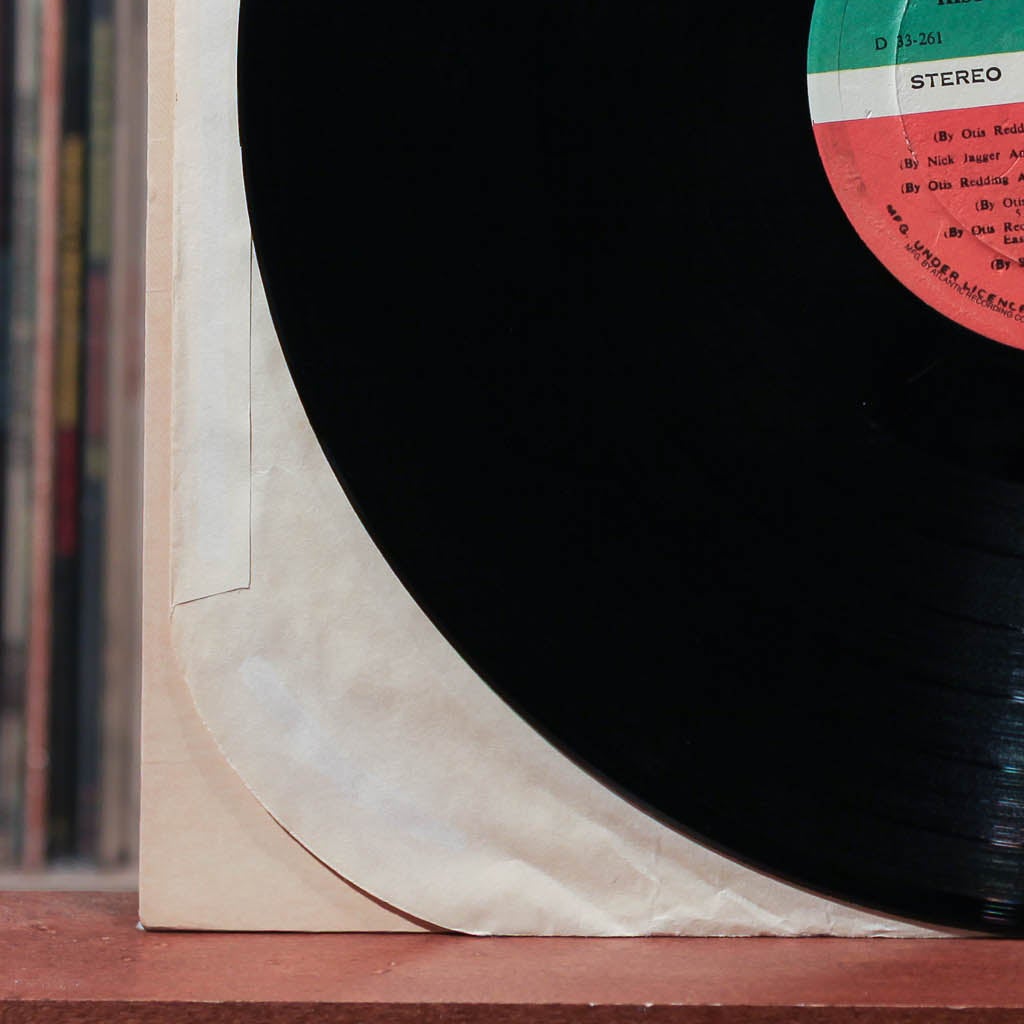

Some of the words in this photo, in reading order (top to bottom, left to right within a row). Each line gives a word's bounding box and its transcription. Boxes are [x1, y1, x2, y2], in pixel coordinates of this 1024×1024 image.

[875, 37, 888, 50] D
[911, 67, 1002, 89] STEREO
[933, 131, 953, 143] (By
[961, 128, 986, 140] Otis
[900, 158, 919, 170] (By
[928, 155, 955, 167] Nick
[963, 152, 1000, 164] Jagger
[901, 182, 920, 194] (By
[928, 179, 952, 191] Otis
[960, 175, 1009, 188] Redding
[975, 200, 995, 212] (By
[944, 227, 963, 239] (By
[971, 224, 996, 236] Otis
[914, 240, 959, 281] UNDER
[991, 258, 1011, 270] (By
[921, 259, 933, 270] BY
[930, 268, 966, 296] ATLANTIC
[966, 290, 1014, 319] RECORDING
